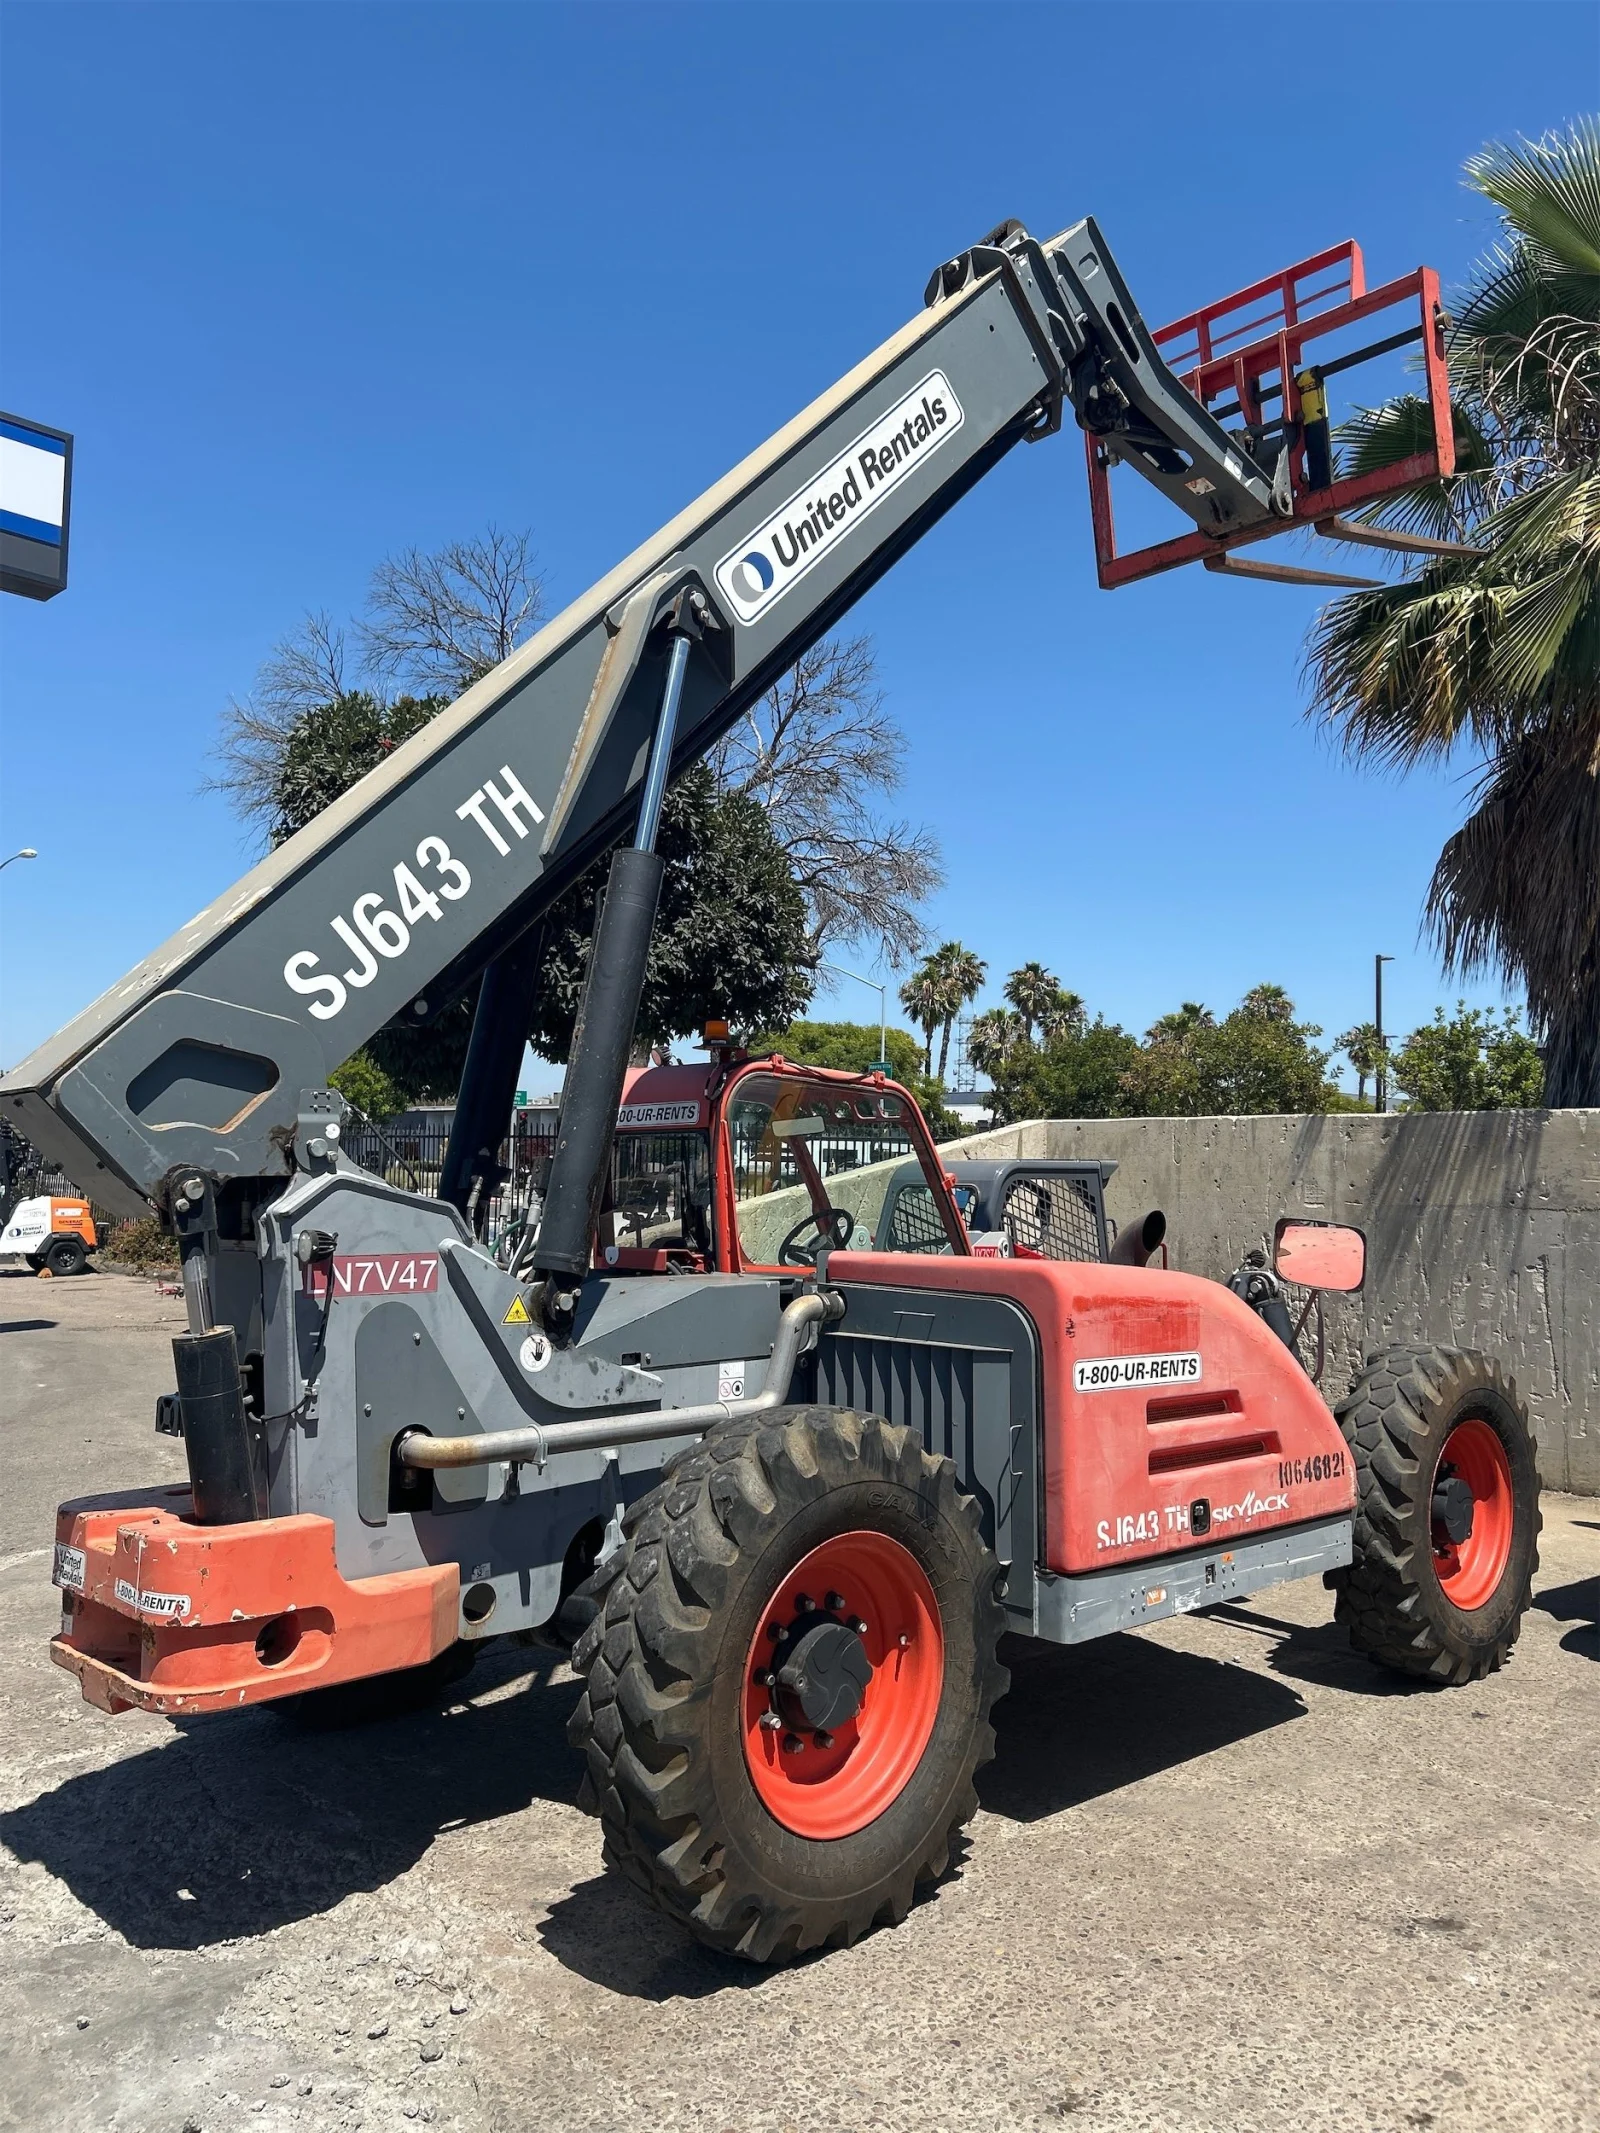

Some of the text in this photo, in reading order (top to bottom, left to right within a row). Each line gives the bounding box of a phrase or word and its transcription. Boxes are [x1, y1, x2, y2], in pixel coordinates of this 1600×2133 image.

[770, 396, 948, 568] United Rentals
[283, 764, 546, 1021] SJ643 TH
[619, 1105, 696, 1123] 00-UR-RENTS
[306, 1259, 438, 1295] LN7V47
[1078, 1358, 1198, 1386] 1-800-UR-RENTS
[1278, 1451, 1345, 1488] 10646821
[1164, 1504, 1189, 1534] TH
[1212, 1490, 1290, 1523] SKYJACK
[59, 1550, 82, 1570] United
[58, 1565, 83, 1586] Rentals
[117, 1583, 185, 1613] 1-800-U-RENTS
